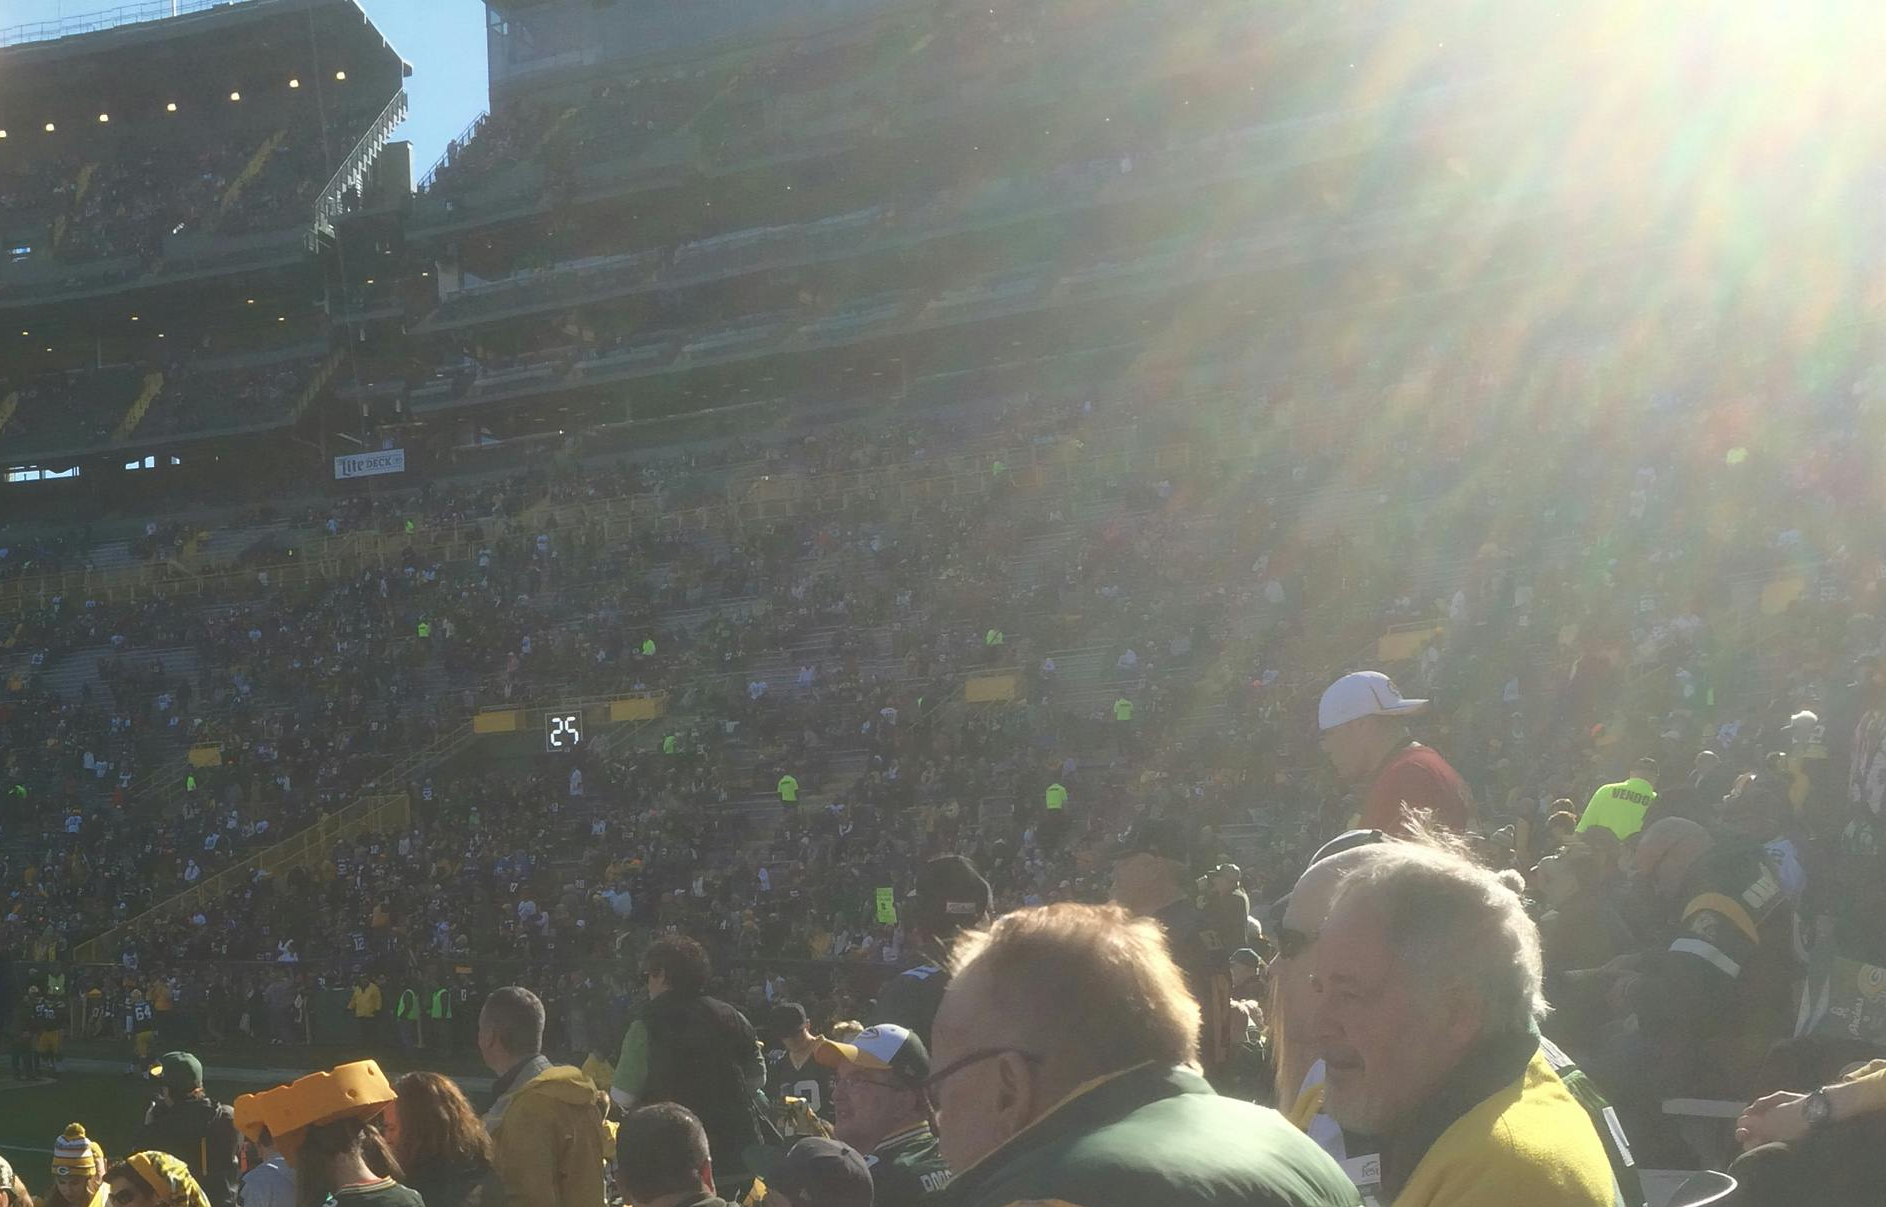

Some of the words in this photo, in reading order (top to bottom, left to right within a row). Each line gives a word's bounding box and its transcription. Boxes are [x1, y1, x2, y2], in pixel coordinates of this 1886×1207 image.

[340, 457, 364, 477] Lite
[366, 458, 391, 469] DECK
[550, 716, 579, 747] 25
